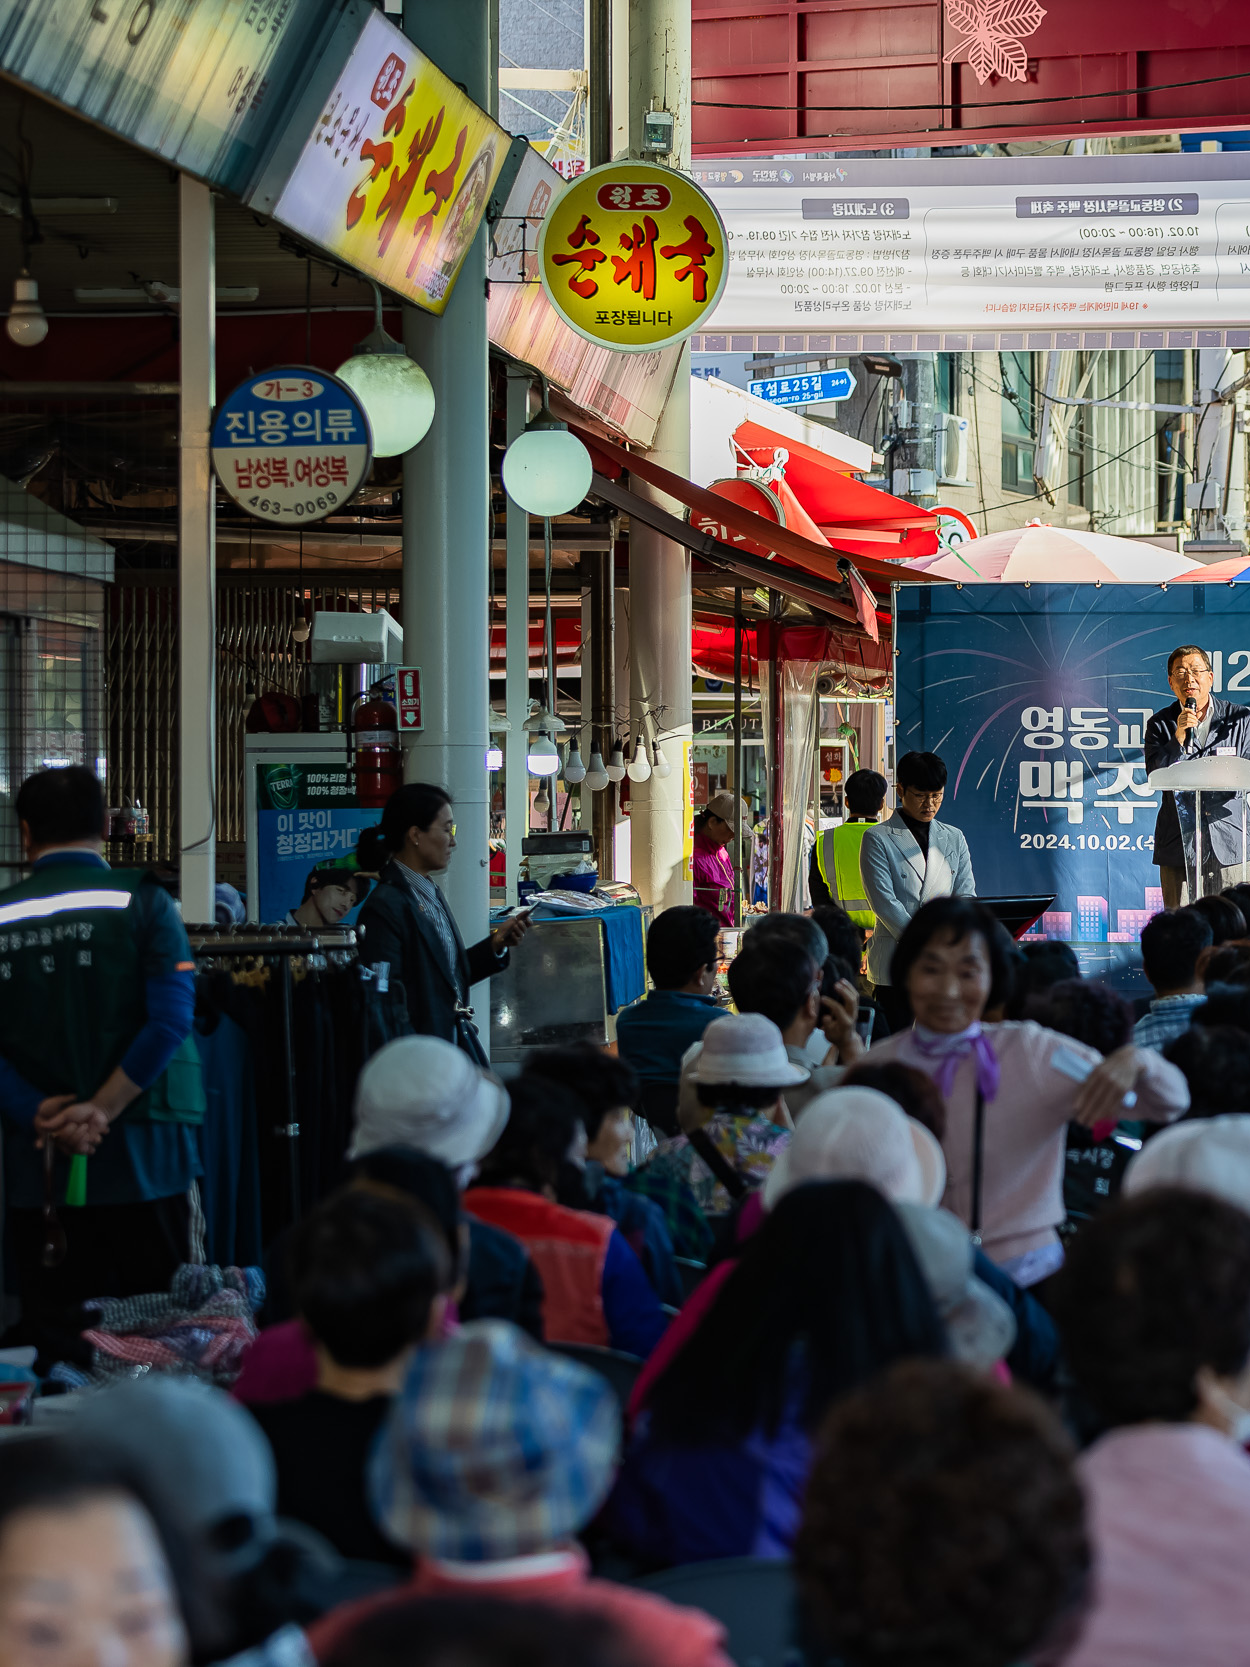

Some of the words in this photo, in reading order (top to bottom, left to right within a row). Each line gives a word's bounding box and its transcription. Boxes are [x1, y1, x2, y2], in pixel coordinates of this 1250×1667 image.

[609, 185, 662, 209] 원조
[551, 214, 716, 303] 순대국
[594, 310, 674, 327] 포장됩니다
[264, 380, 315, 400] 가-3
[225, 408, 357, 445] 진용의류
[234, 455, 350, 490] 남성복.여성복
[248, 491, 339, 517] 463-0069
[401, 698, 420, 707] 소화기
[702, 719, 766, 732] BEAUT
[306, 773, 329, 784] 100%
[306, 786, 329, 796] 100%
[1018, 760, 1159, 825] 맥주
[277, 813, 294, 832] 이
[298, 809, 332, 831] 맛이
